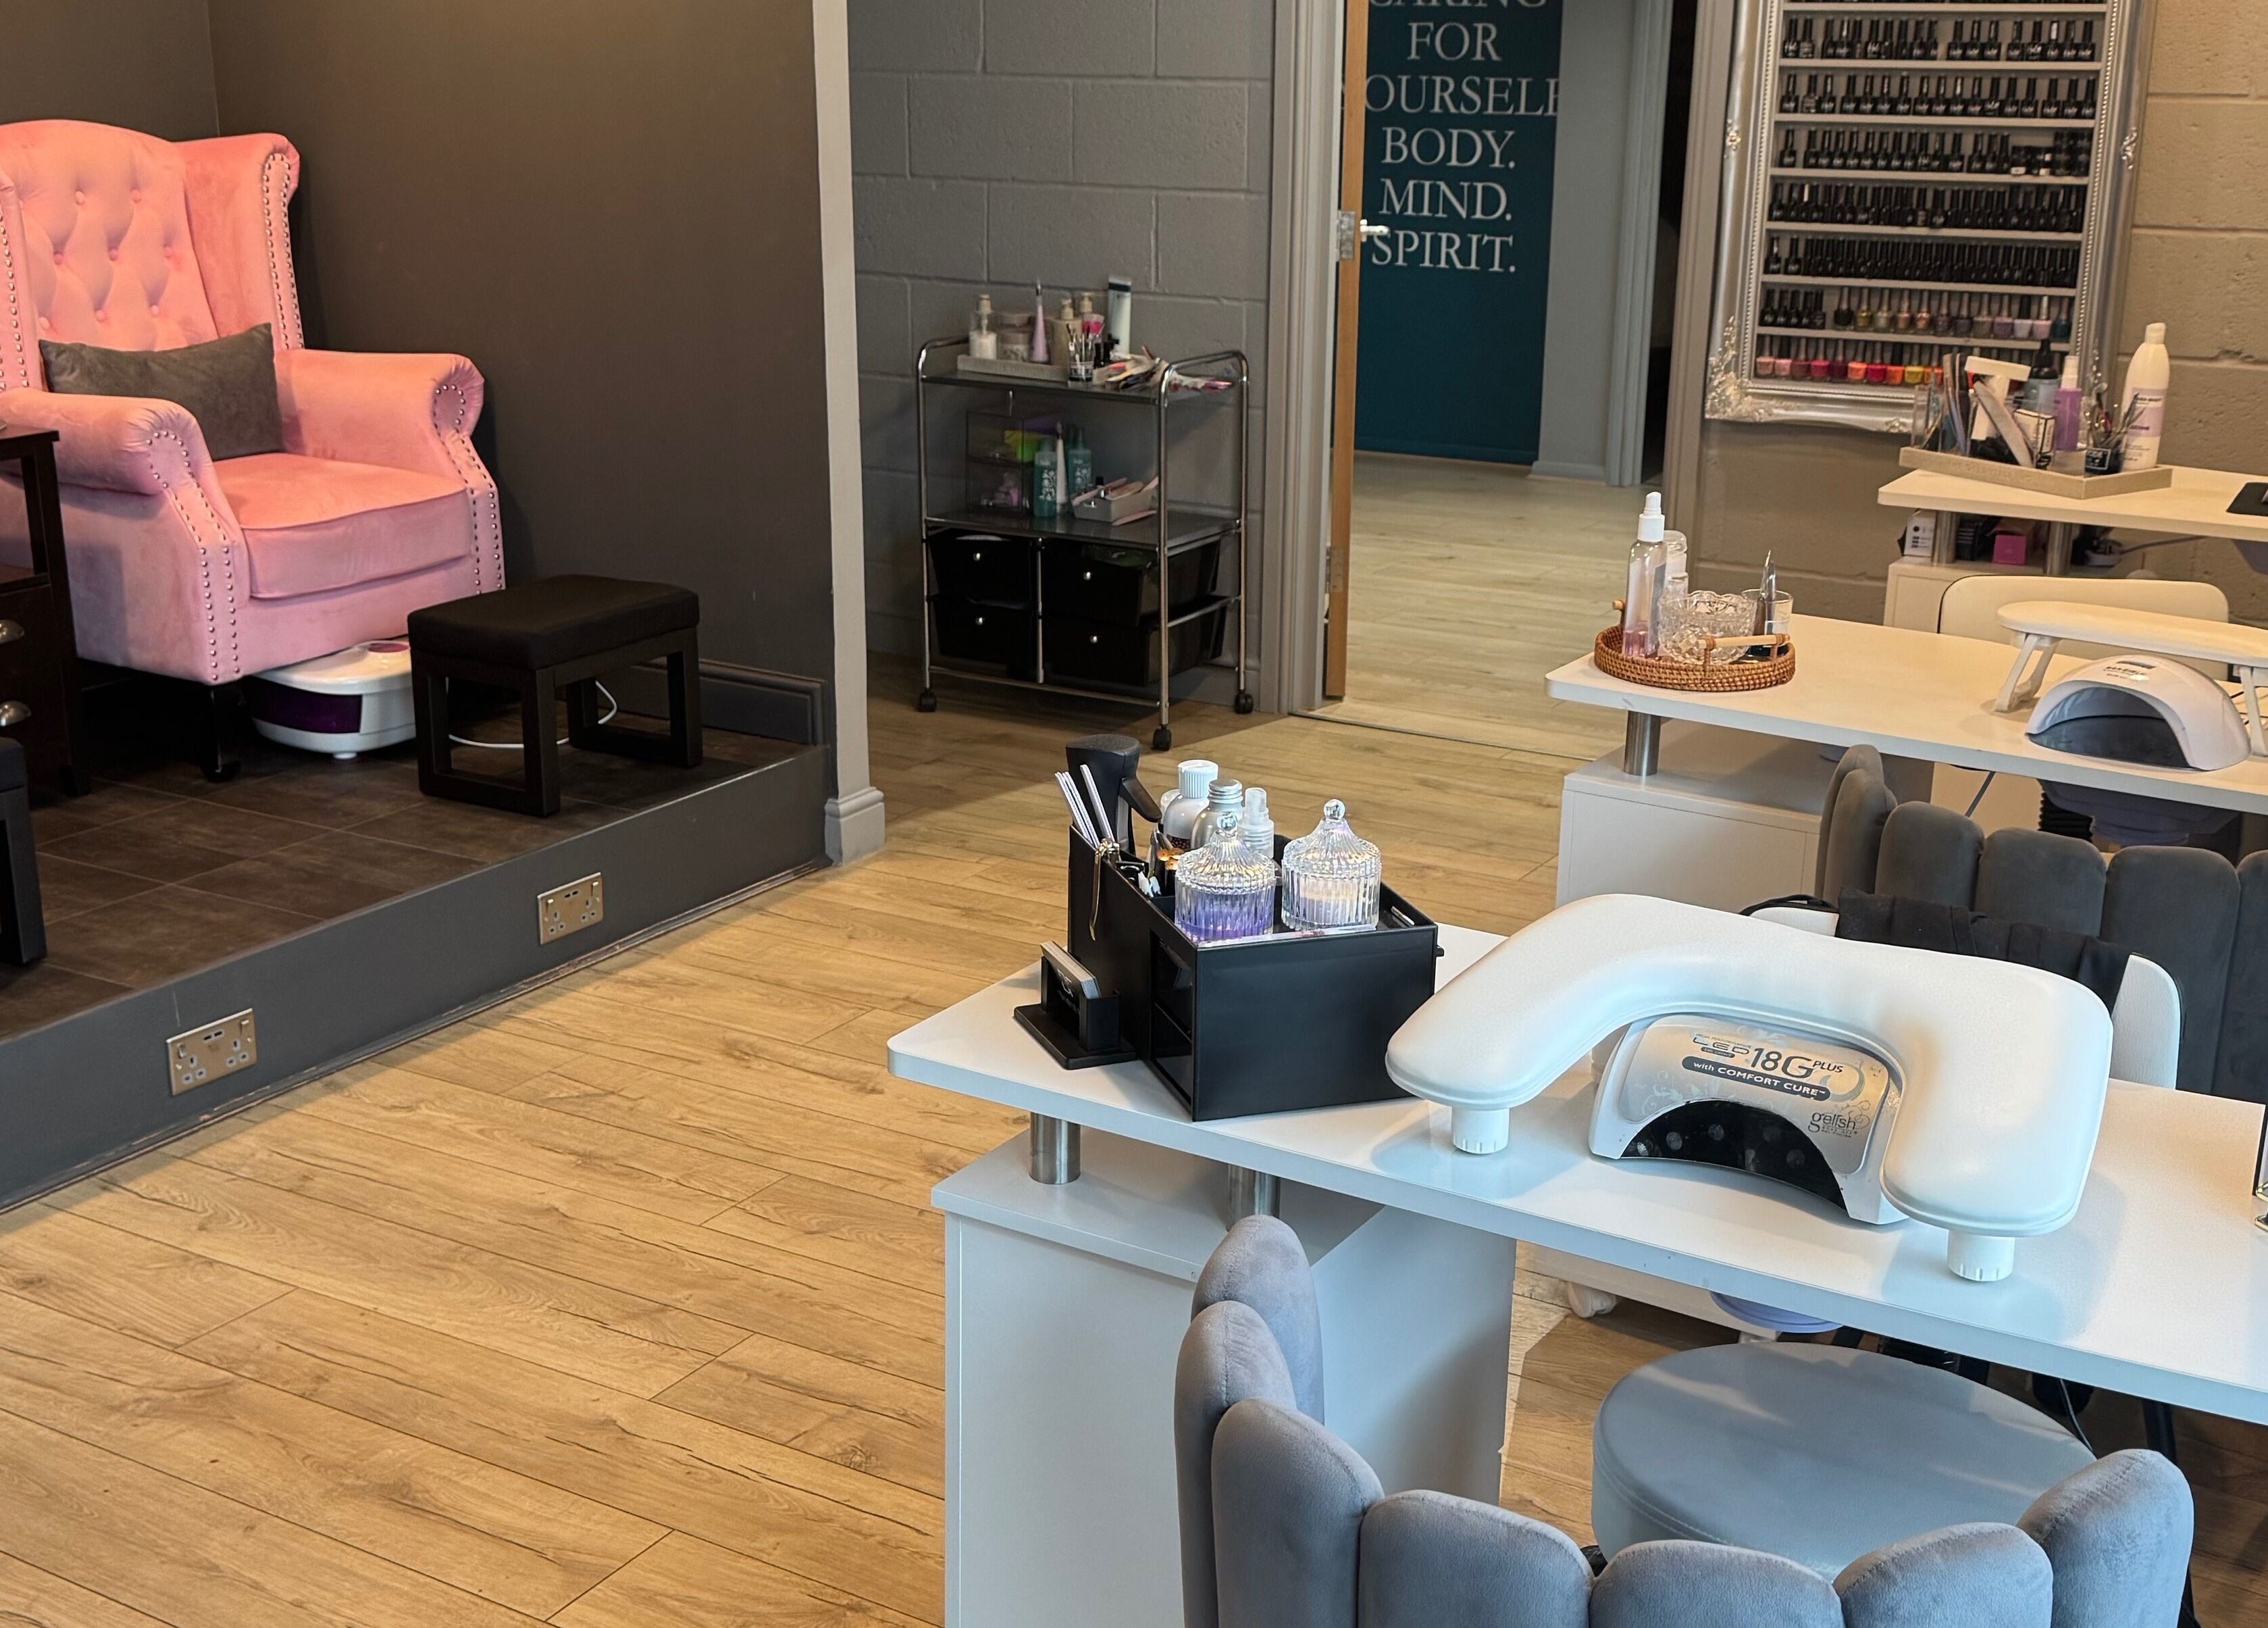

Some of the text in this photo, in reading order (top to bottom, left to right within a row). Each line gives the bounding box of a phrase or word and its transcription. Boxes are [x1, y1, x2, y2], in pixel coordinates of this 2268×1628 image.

[1406, 22, 1502, 61] FOR
[1365, 74, 1559, 116] OURSELF
[1381, 126, 1516, 169] BODY.
[1378, 178, 1512, 222] MIND.
[1371, 229, 1516, 273] SPIRIT.
[1693, 1036, 1750, 1054] LED
[1812, 1059, 1844, 1073] PLUS
[1693, 1061, 1715, 1072] with
[1717, 1067, 1782, 1087] COMFORT
[1808, 1111, 1856, 1133] gelish
